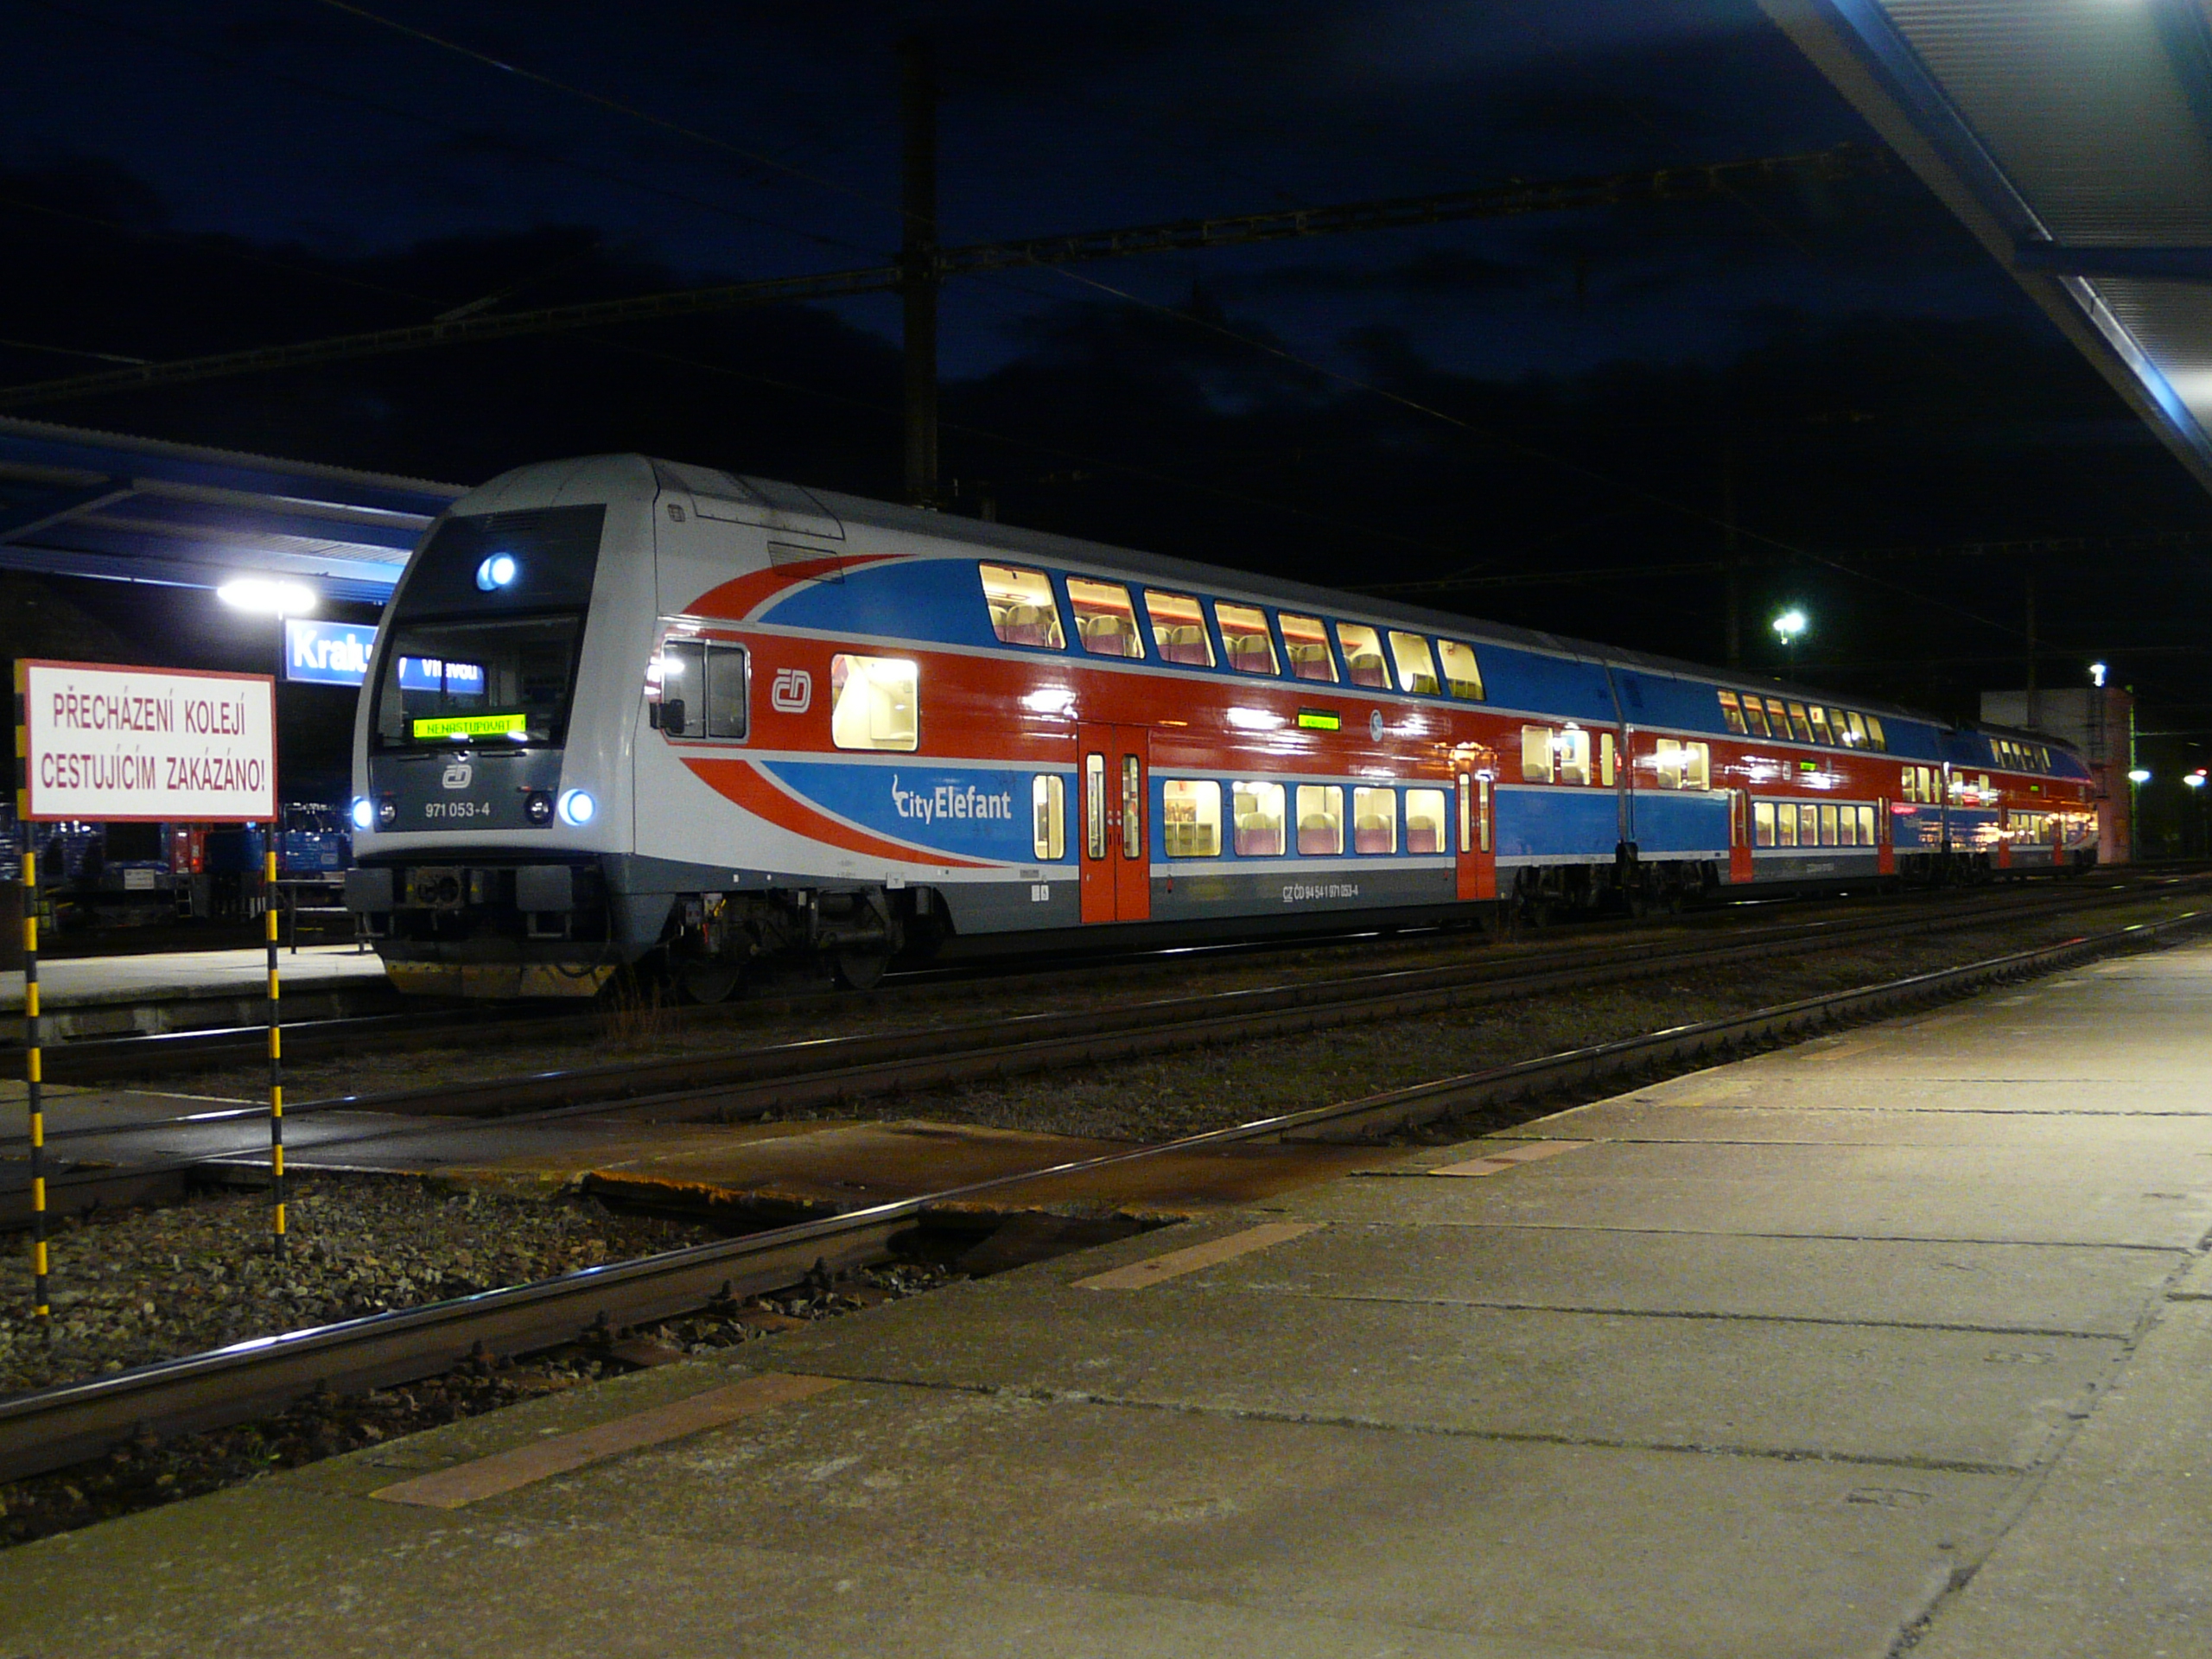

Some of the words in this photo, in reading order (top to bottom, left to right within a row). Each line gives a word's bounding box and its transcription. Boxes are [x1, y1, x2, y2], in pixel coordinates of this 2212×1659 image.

[53, 684, 174, 732] PŘECHÁZENÍ
[185, 692, 245, 735] KOLEJÍ
[41, 744, 156, 790] CESTUJÍCÍM
[167, 747, 265, 791] ZAKÁZÁNO!
[425, 803, 446, 817] 971
[448, 802, 490, 817] 053-4
